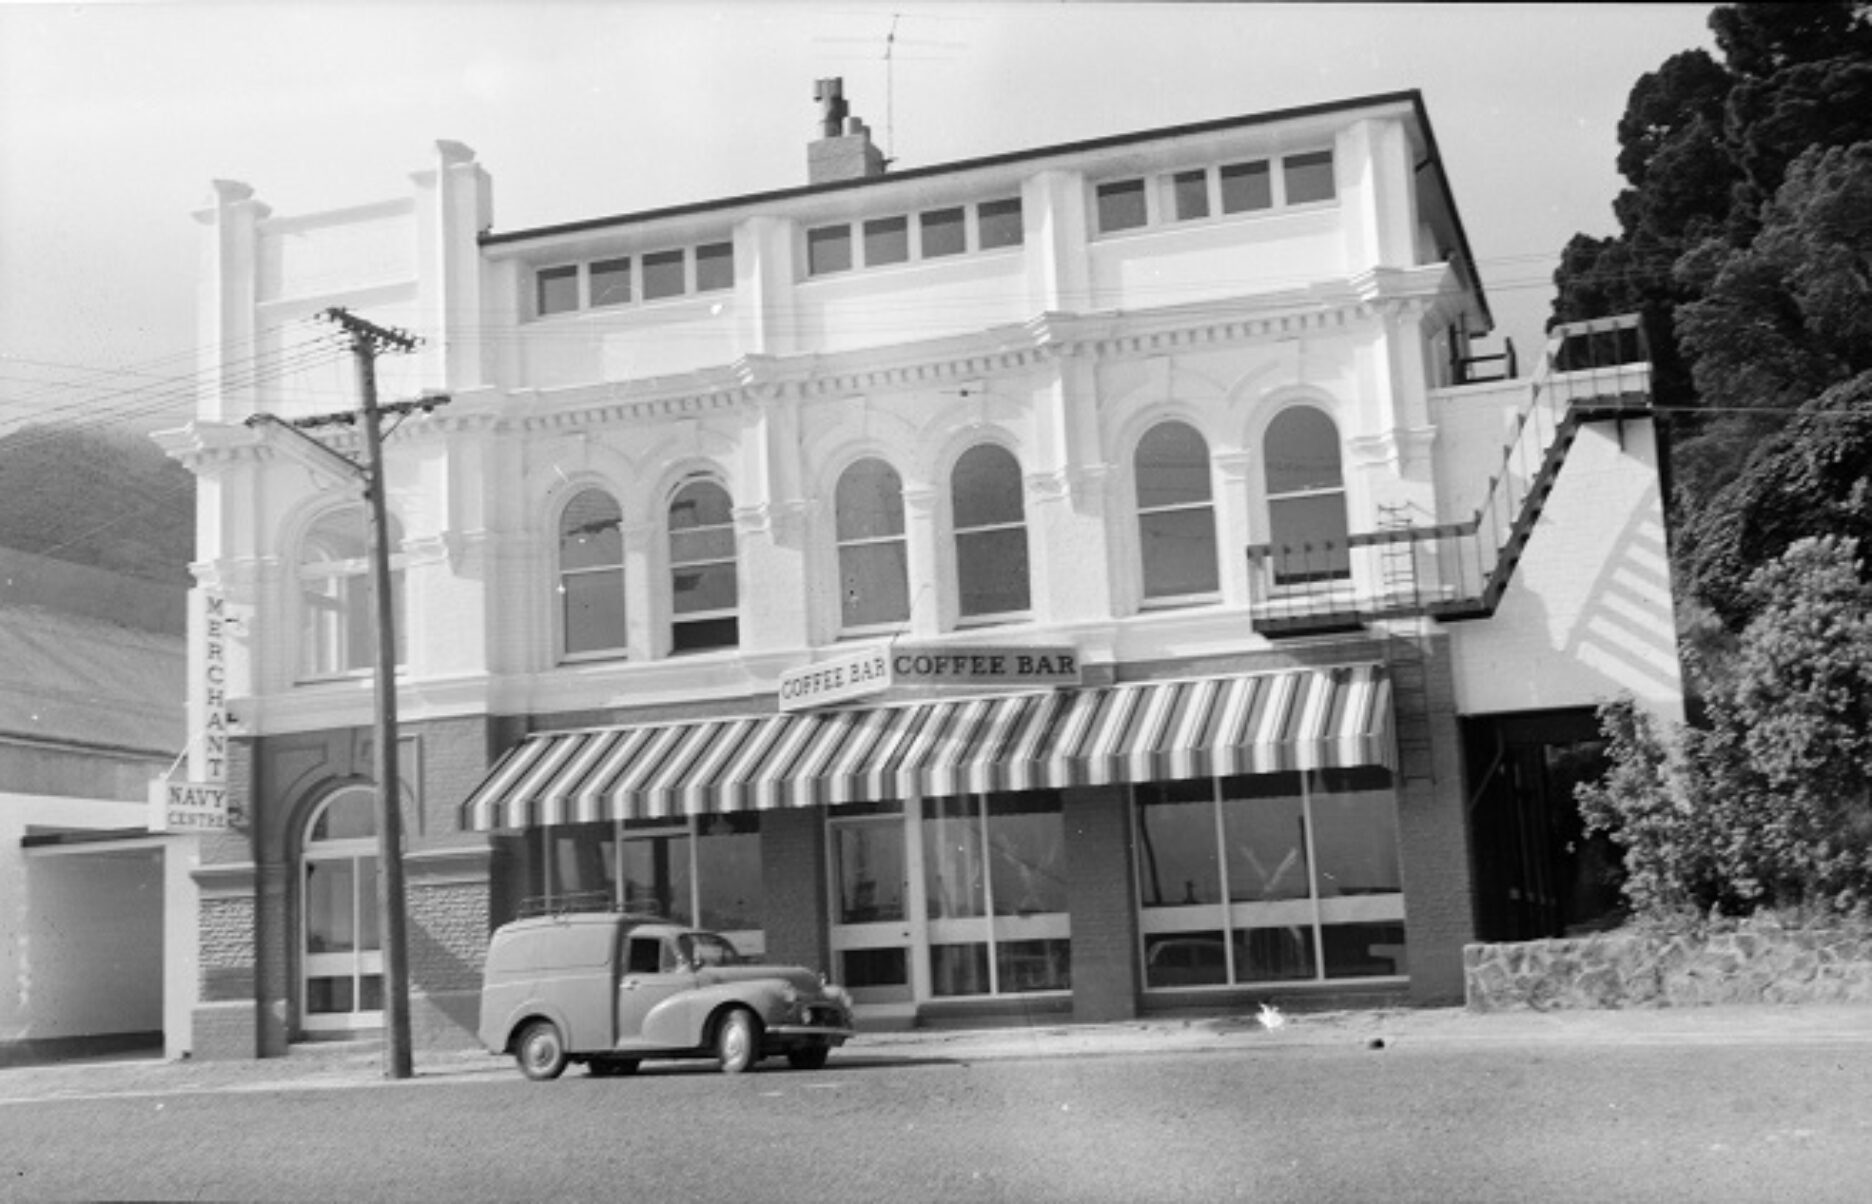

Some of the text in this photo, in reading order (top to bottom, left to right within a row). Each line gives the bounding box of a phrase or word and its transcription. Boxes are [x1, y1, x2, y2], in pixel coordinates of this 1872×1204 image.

[893, 655, 1078, 675] COFFEE BAR
[206, 596, 224, 777] MERCHANT
[780, 657, 887, 700] COFFEE BAR
[169, 786, 226, 808] NAVY
[167, 811, 226, 828] CENTRE
